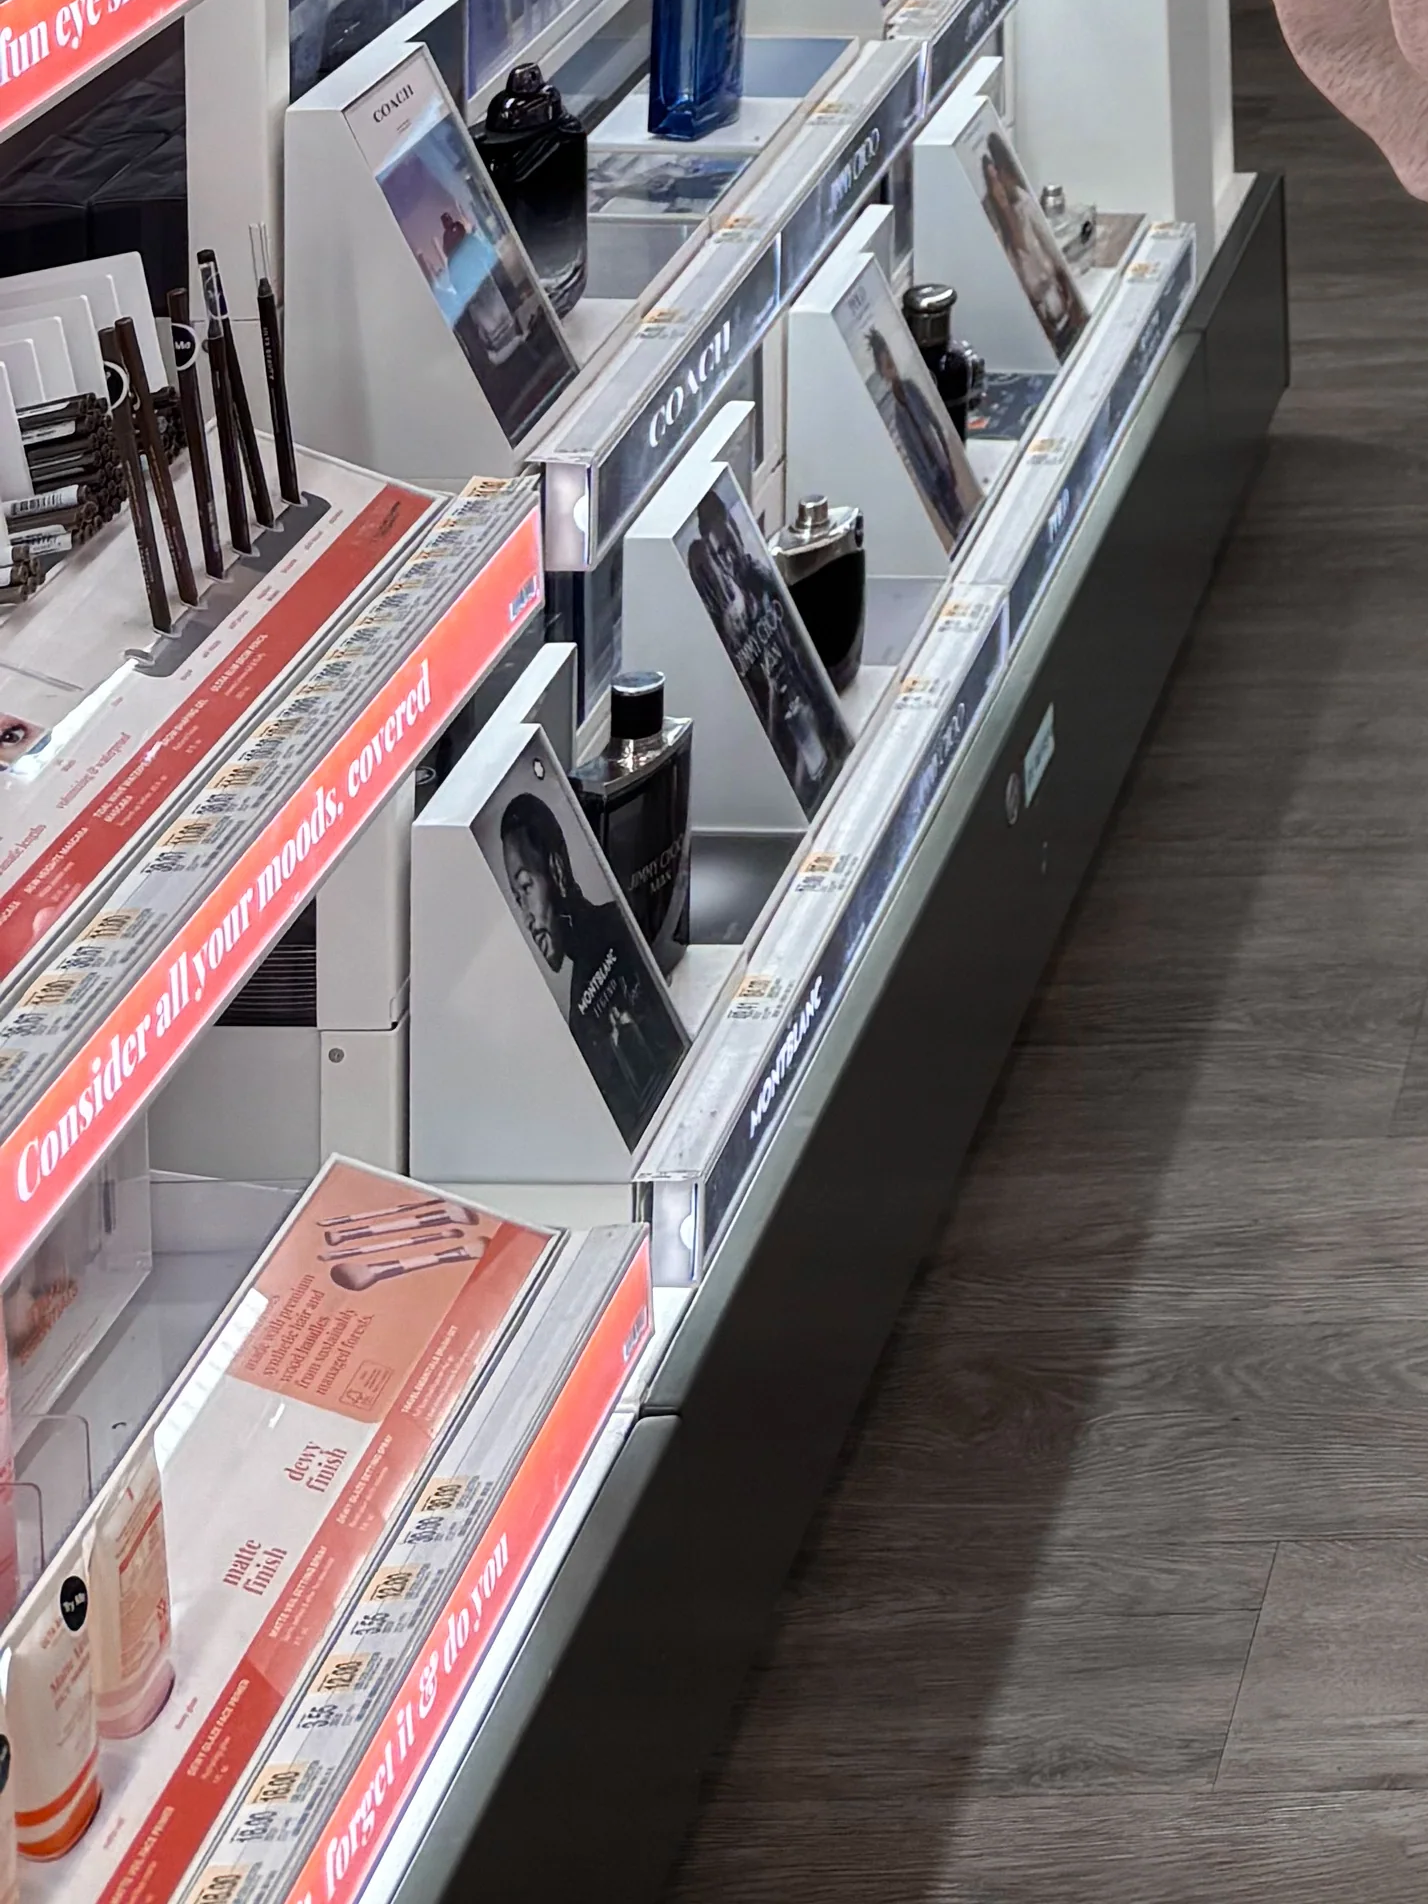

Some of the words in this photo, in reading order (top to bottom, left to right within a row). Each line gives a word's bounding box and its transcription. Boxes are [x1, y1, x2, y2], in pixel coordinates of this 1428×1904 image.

[0, 20, 49, 85] fun
[373, 85, 415, 123] COACH
[648, 321, 731, 448] COACH
[16, 1011, 151, 1203] Consider
[155, 948, 191, 1040] all
[194, 883, 255, 1002] your
[347, 659, 432, 800] covered
[578, 947, 617, 1015] MONTBLANC
[749, 975, 823, 1138] MONTBLANC
[264, 1327, 299, 1378] synthetic
[296, 1303, 313, 1334] hair
[308, 1289, 326, 1317] and
[267, 1315, 287, 1348] with
[279, 1272, 315, 1328] premium
[280, 1353, 302, 1385] wood
[297, 1315, 331, 1359] handles
[297, 1362, 318, 1391] from
[314, 1306, 358, 1370] sustainably
[316, 1348, 351, 1398] managed
[345, 1313, 376, 1358] forests.
[284, 1441, 321, 1484] dewy
[306, 1447, 348, 1493] finish
[223, 1539, 262, 1587] matte
[242, 1547, 288, 1596] finish
[323, 1744, 396, 1902] forget
[396, 1706, 415, 1767] it
[418, 1649, 441, 1721] &
[442, 1615, 471, 1676] do
[471, 1531, 510, 1632] you
